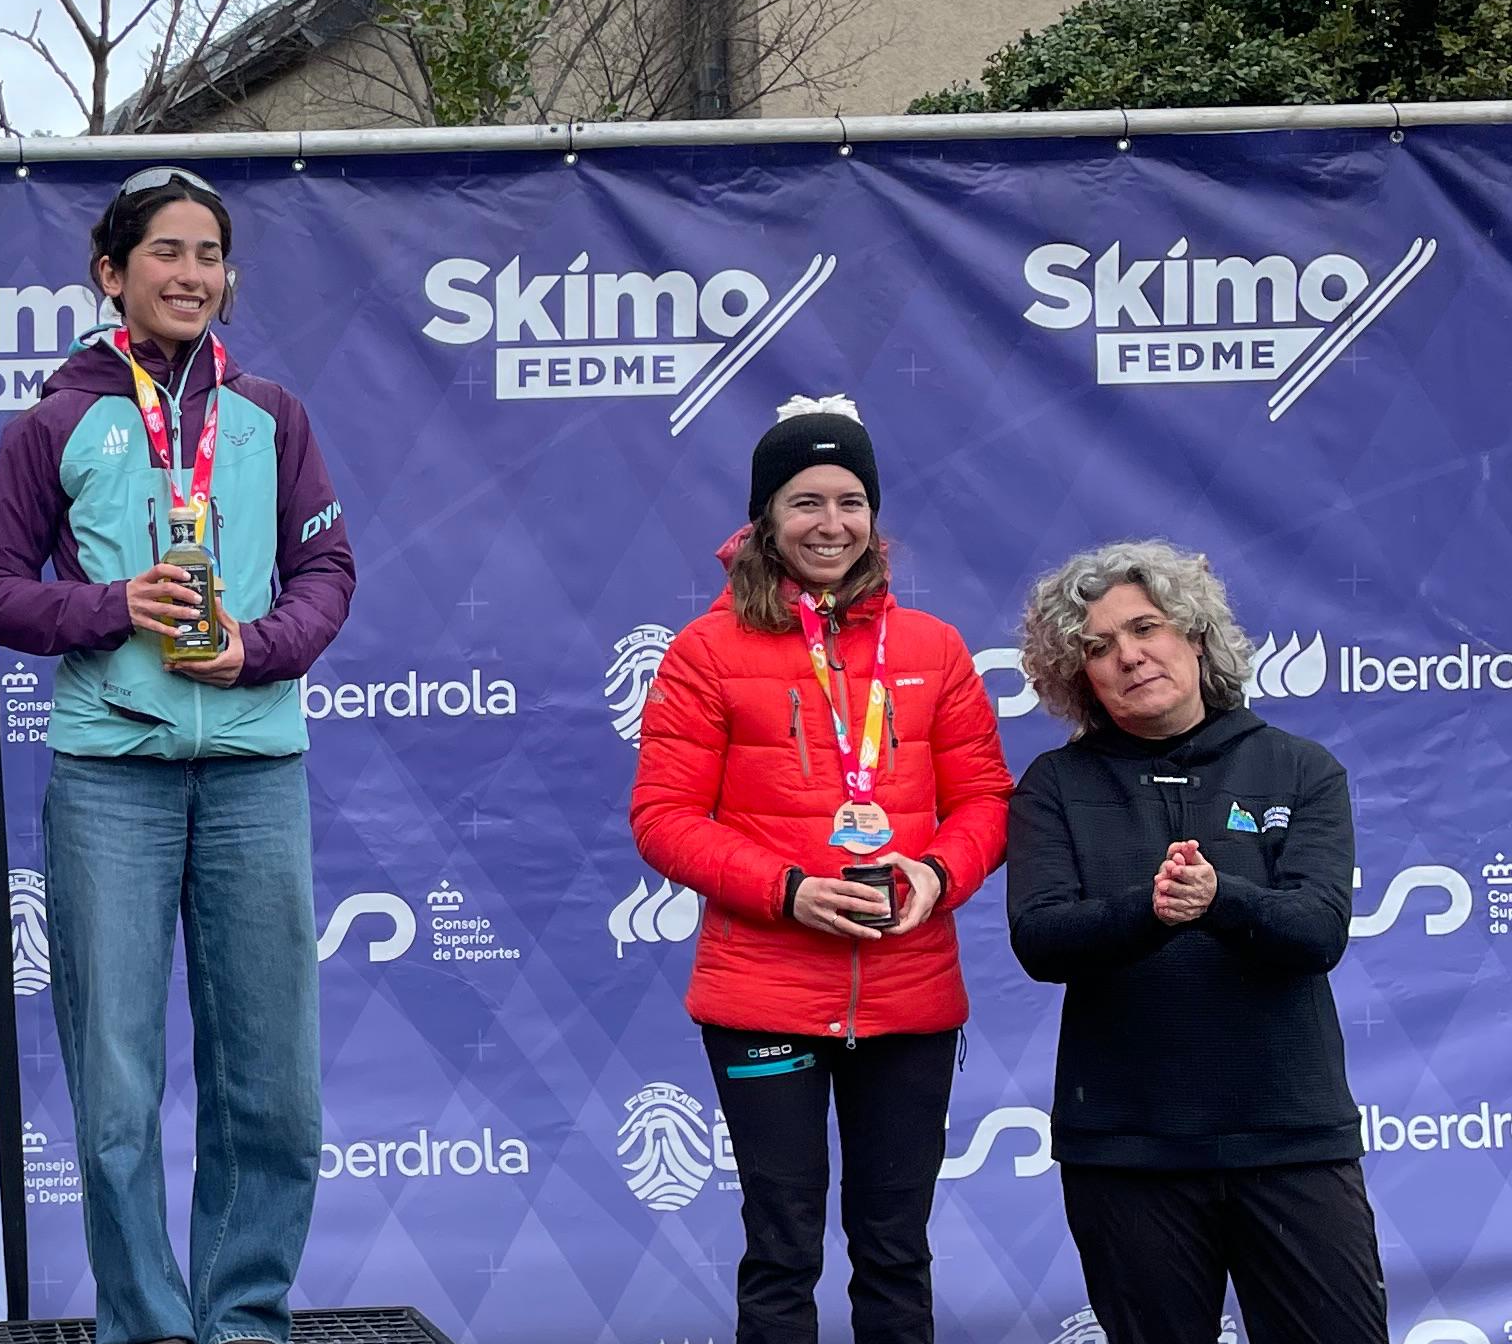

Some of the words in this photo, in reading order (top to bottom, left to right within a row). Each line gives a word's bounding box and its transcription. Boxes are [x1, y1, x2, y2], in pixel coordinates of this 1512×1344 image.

[422, 252, 769, 344] Skimo
[1023, 237, 1369, 329] Skimo
[518, 355, 676, 388] FEDME
[1118, 340, 1276, 372] FEDME
[302, 497, 342, 544] DYN
[1340, 643, 1512, 693] Iberdro
[300, 669, 516, 719] berdrola
[7, 714, 50, 729] Super
[7, 730, 25, 743] de
[432, 916, 490, 932] Consejo
[433, 931, 495, 947] Superior
[433, 947, 451, 960] de
[455, 947, 520, 962] Deportes
[1358, 1101, 1512, 1152] Iberdr
[24, 1173, 79, 1190] uperior
[39, 1190, 83, 1205] Depor
